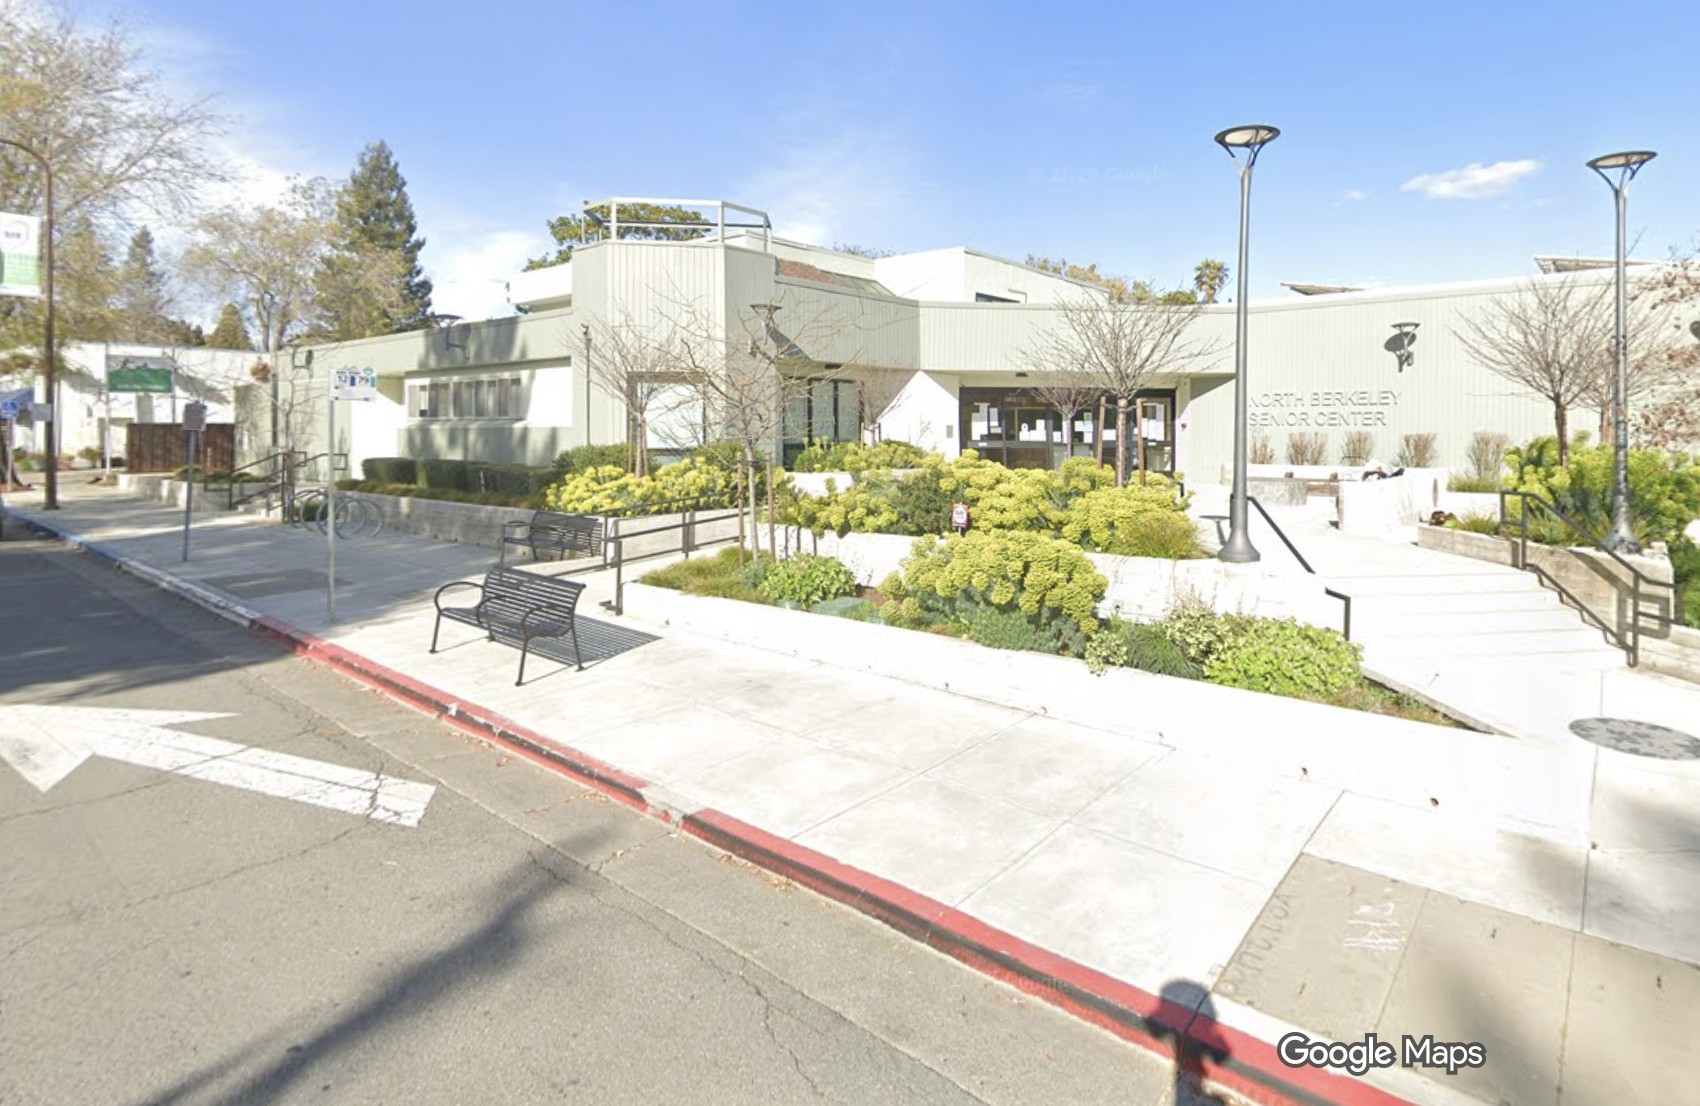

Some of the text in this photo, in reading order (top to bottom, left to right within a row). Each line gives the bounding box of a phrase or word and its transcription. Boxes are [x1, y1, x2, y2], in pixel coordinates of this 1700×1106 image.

[1249, 391, 1403, 407] NORTH BERKELEY
[1249, 412, 1387, 427] SENIOR CENTER
